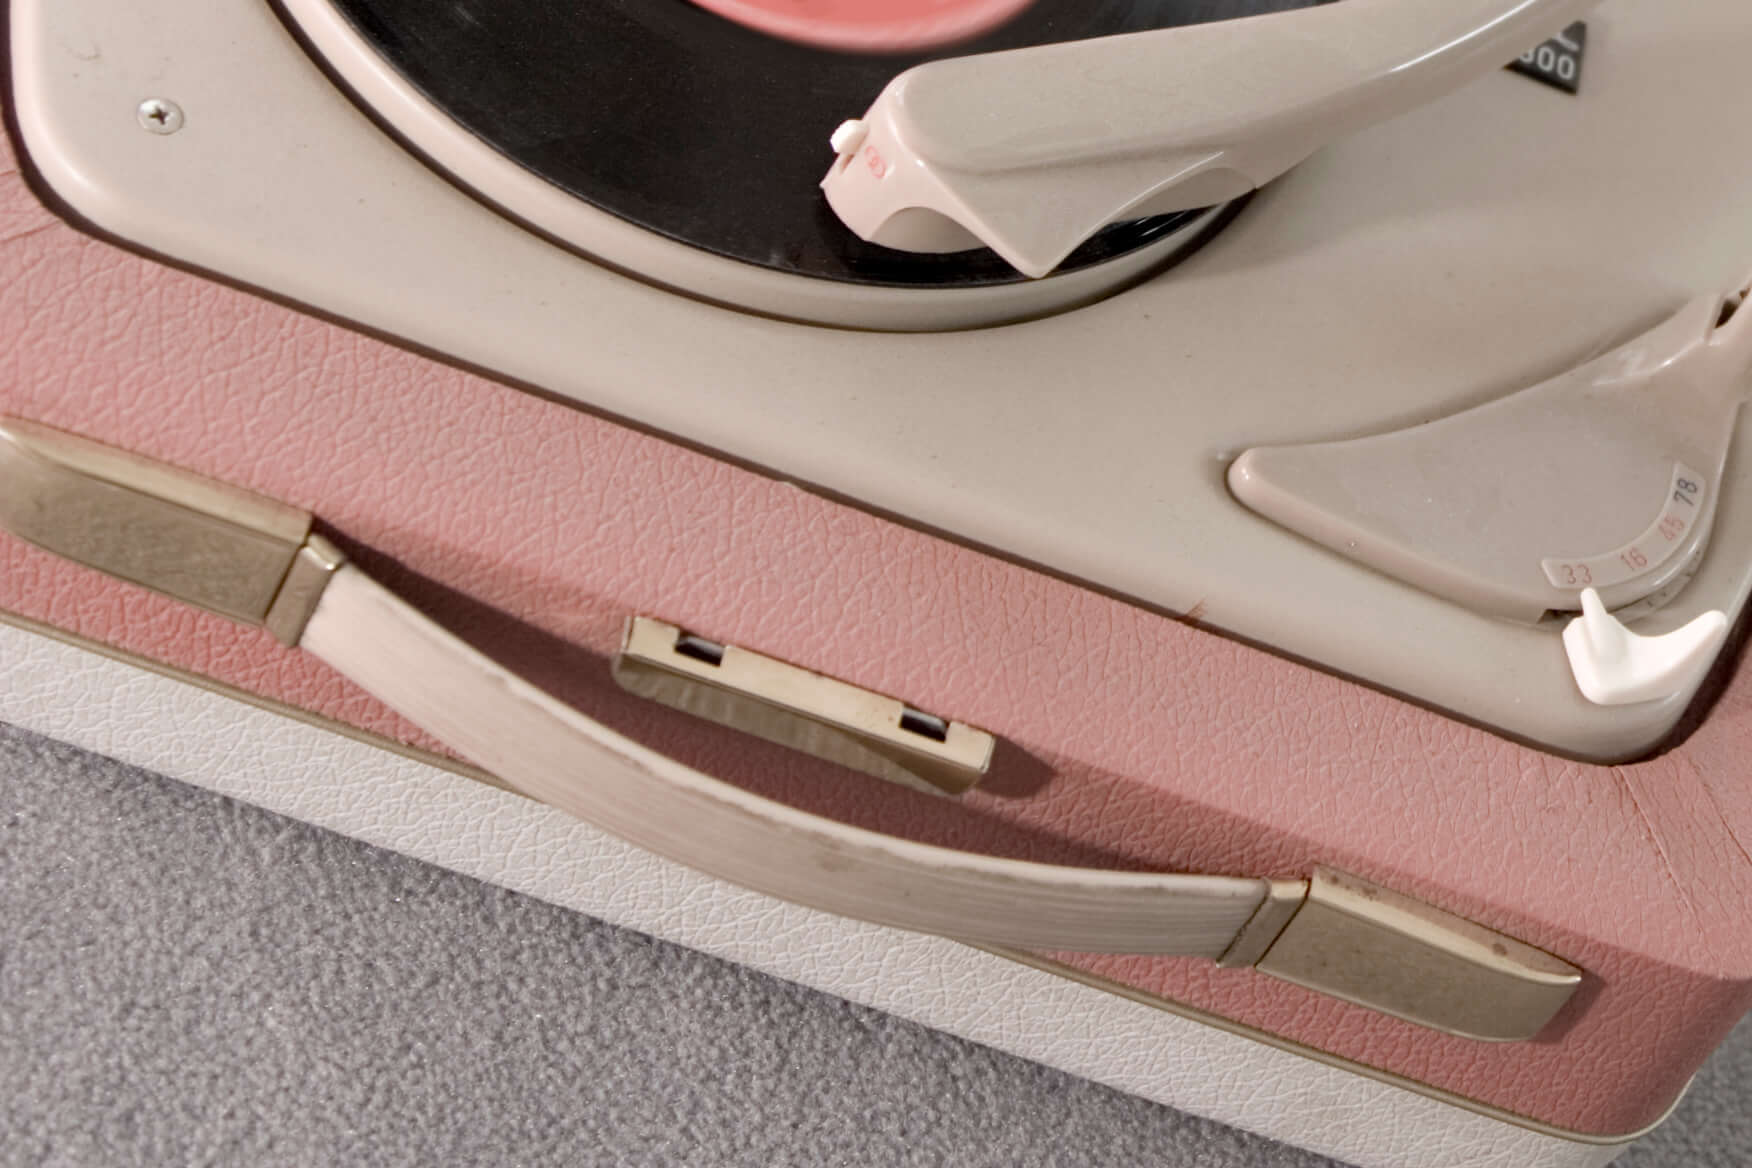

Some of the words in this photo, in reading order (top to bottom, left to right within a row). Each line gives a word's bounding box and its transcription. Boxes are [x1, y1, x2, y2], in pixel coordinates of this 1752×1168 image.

[1561, 563, 1593, 586] 33
[1619, 547, 1648, 572] 16
[1658, 513, 1686, 542] 45
[1673, 477, 1698, 507] 78
